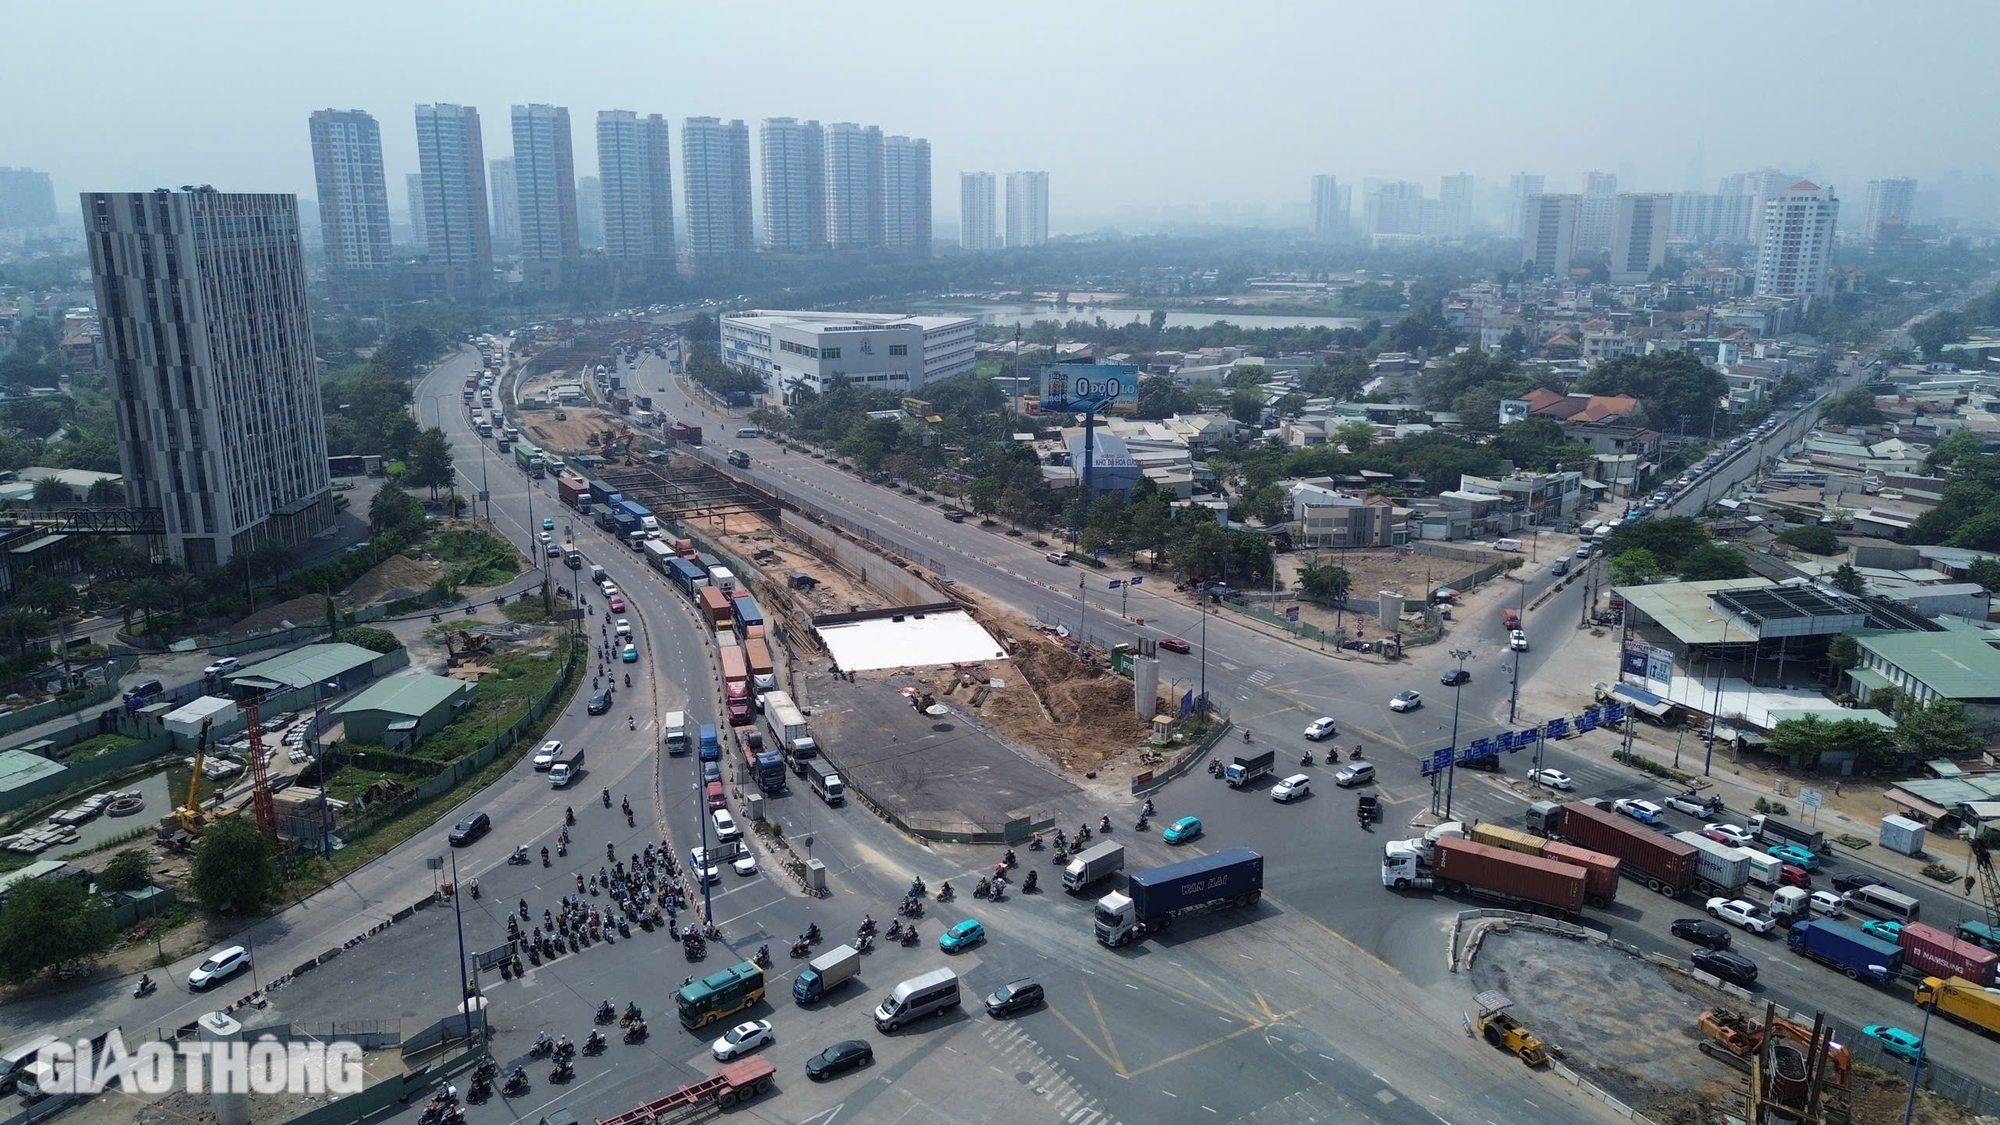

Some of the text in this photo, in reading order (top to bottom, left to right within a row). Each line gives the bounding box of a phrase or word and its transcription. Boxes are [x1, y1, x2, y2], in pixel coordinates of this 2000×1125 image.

[1181, 874, 1228, 896] WAN HAI
[1922, 951, 1965, 974] NAMSUNG
